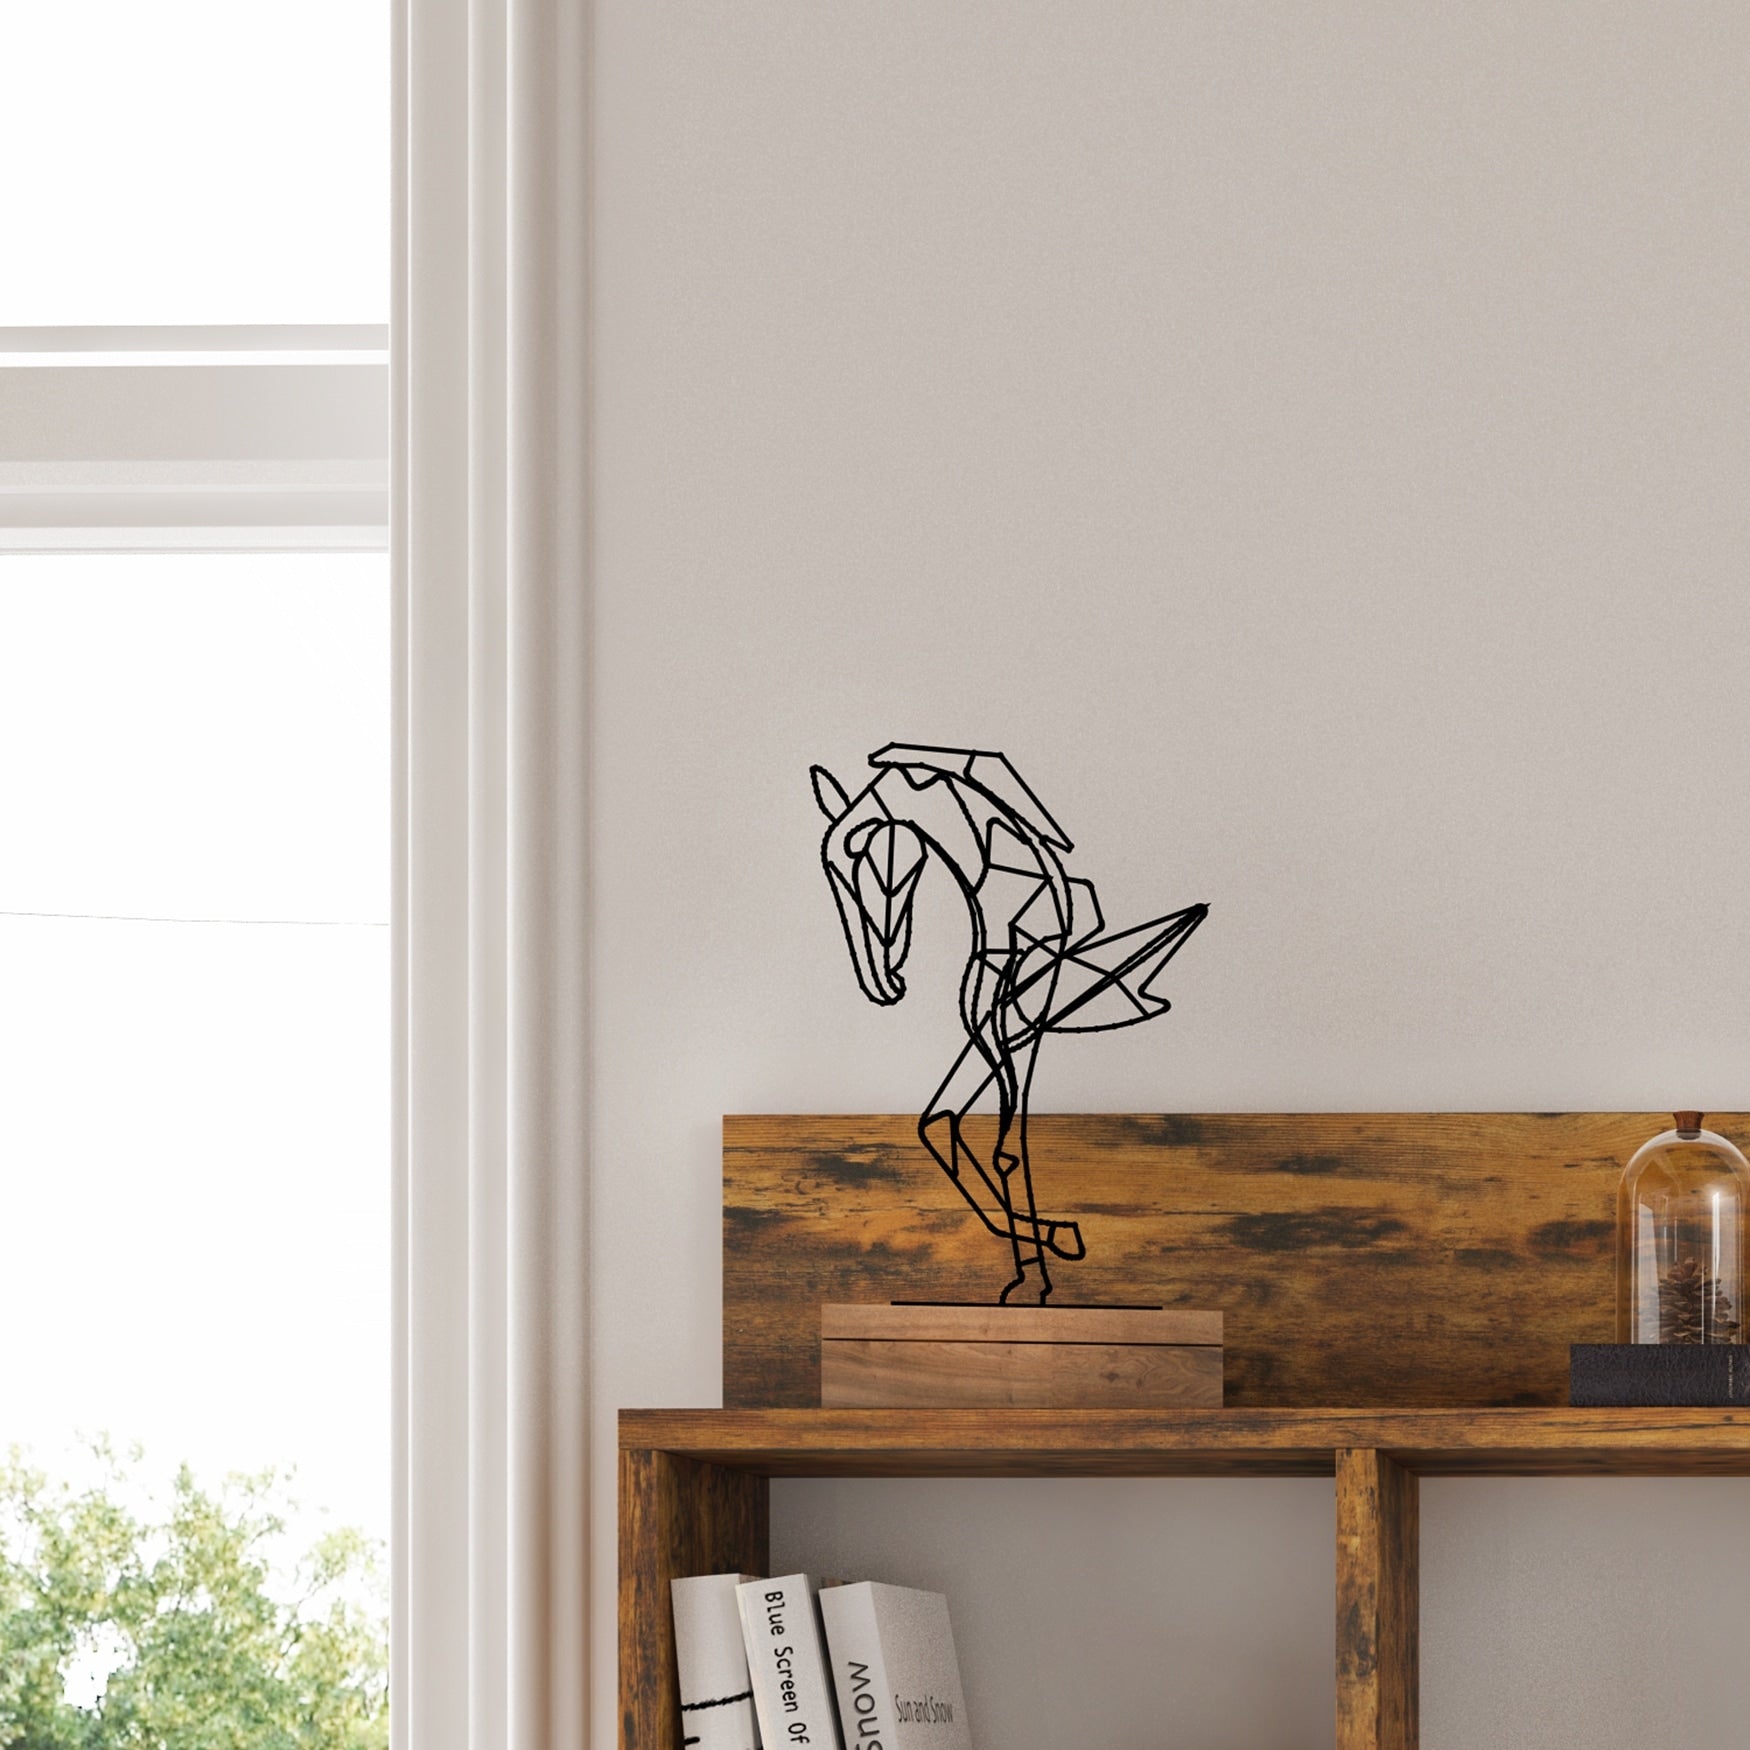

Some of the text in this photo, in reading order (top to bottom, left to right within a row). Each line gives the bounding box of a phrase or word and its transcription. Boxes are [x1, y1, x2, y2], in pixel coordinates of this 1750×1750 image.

[765, 1591, 785, 1636] Blue
[774, 1646, 799, 1713] Screen
[895, 1694, 913, 1722] Sun
[913, 1694, 930, 1723] and
[788, 1722, 808, 1743] Of
